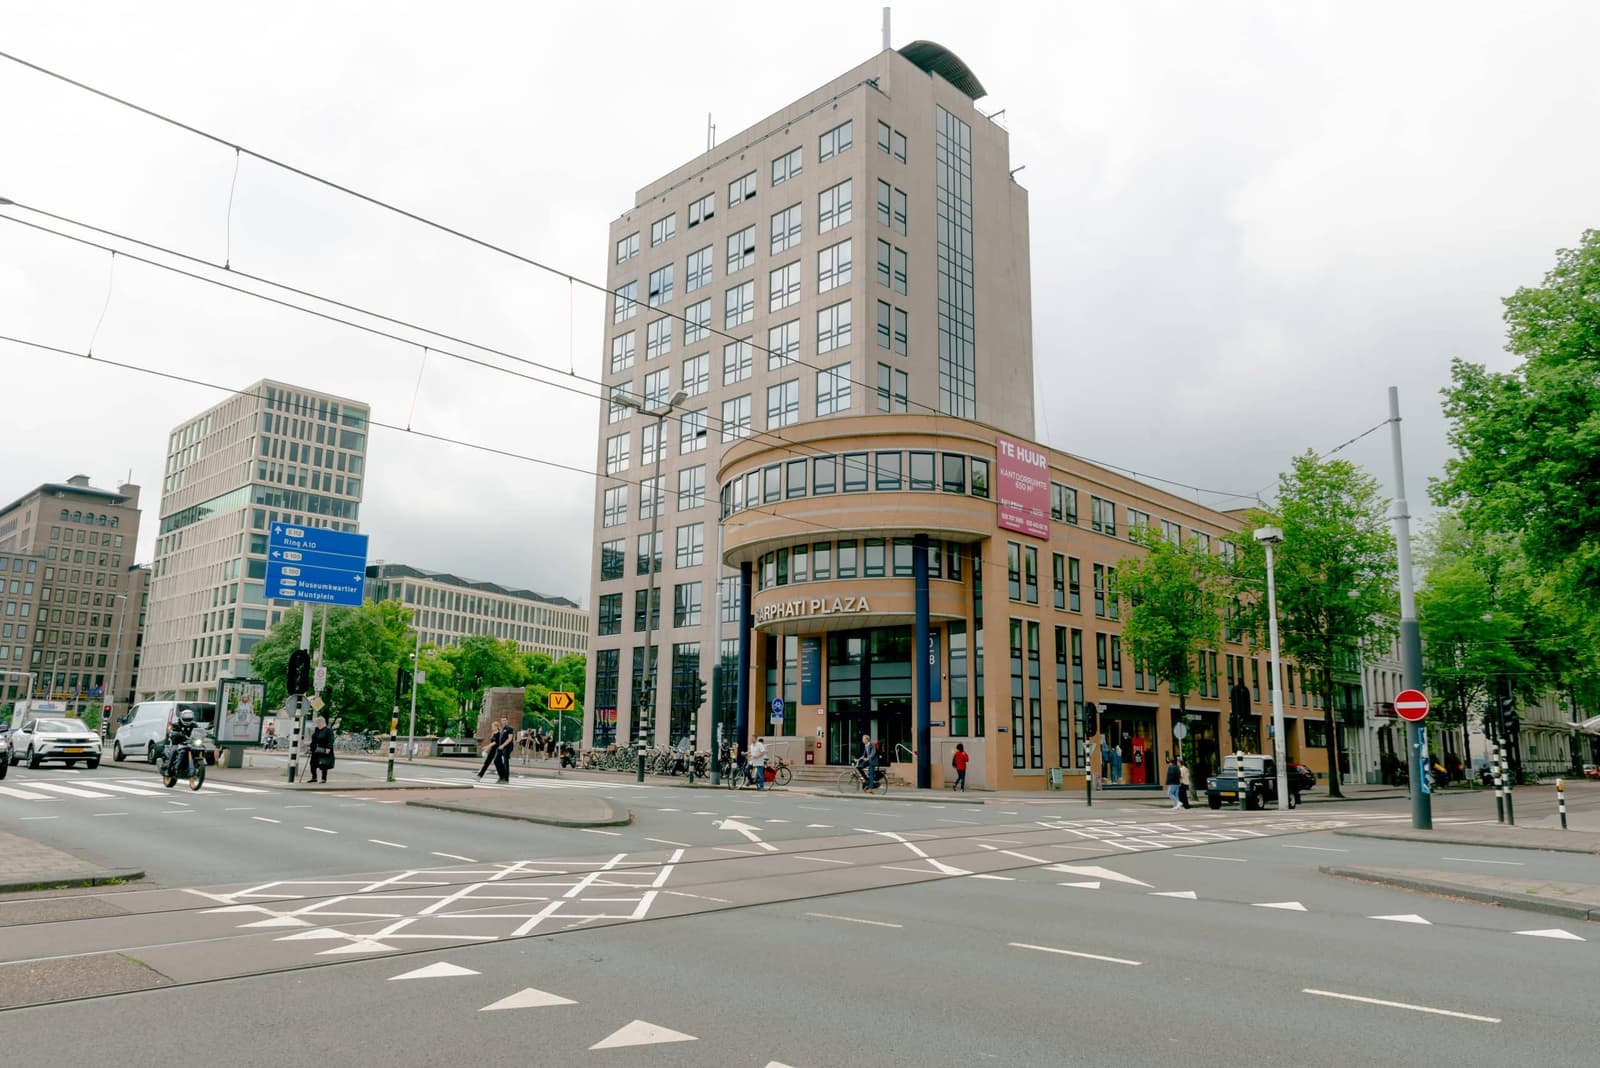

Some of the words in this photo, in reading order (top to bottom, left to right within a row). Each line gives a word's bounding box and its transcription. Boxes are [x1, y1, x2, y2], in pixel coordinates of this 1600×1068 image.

[1000, 440, 1015, 458] TE
[1017, 446, 1047, 469] HUUR
[284, 538, 301, 548] Ring
[302, 540, 317, 549] A10
[299, 580, 357, 593] Museumkwartier
[298, 590, 334, 601] Muntplein
[757, 599, 806, 621] ARPHATI
[810, 596, 870, 614] PLAZA
[555, 695, 563, 705] V
